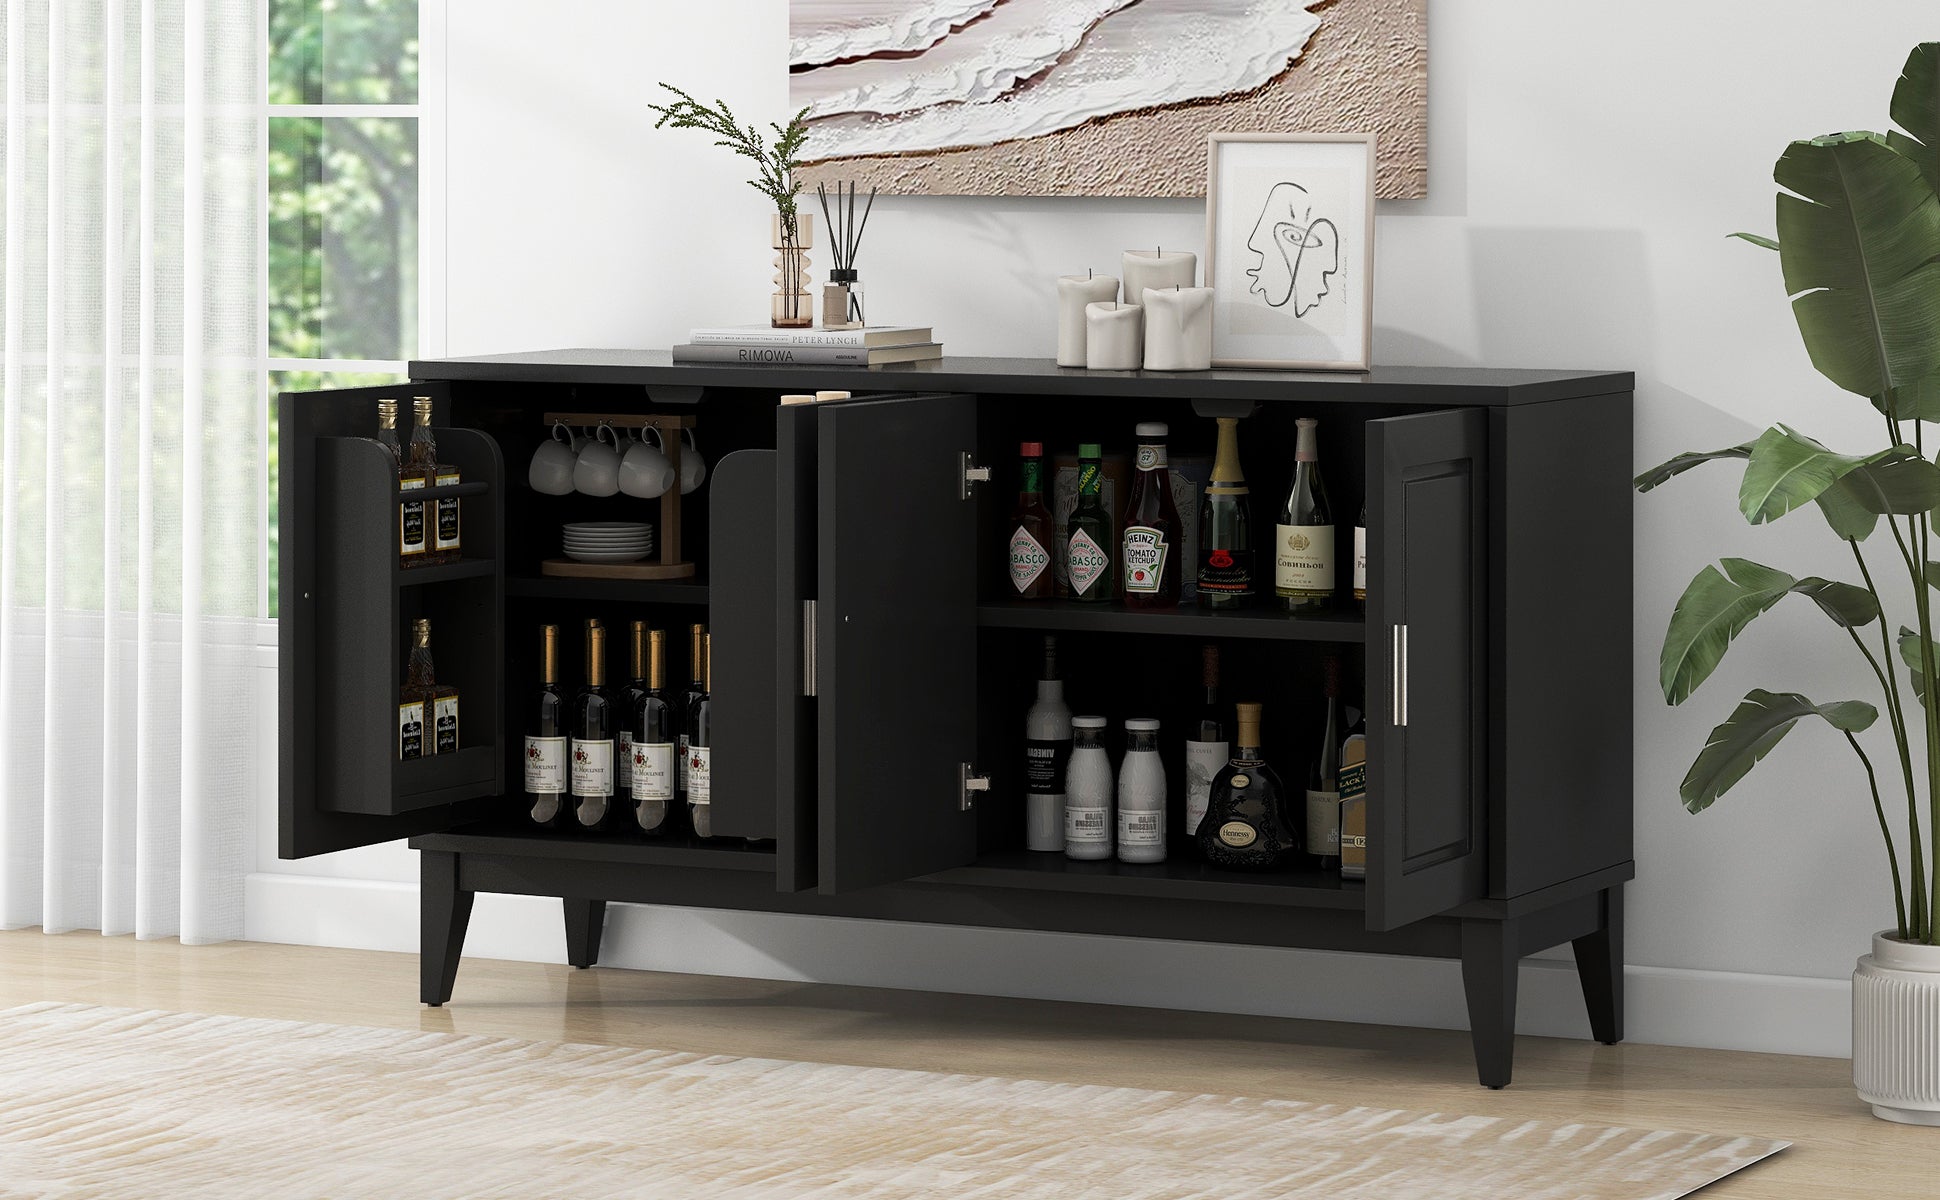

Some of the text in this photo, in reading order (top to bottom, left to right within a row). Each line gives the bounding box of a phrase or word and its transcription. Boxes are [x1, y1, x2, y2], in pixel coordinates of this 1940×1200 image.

[792, 336, 823, 344] PETER
[826, 337, 858, 345] LYNCH
[739, 349, 794, 362] RIMOWA
[1128, 534, 1154, 544] HEINZ
[1127, 549, 1156, 558] TOMATO
[1222, 829, 1249, 839] Hennessy
